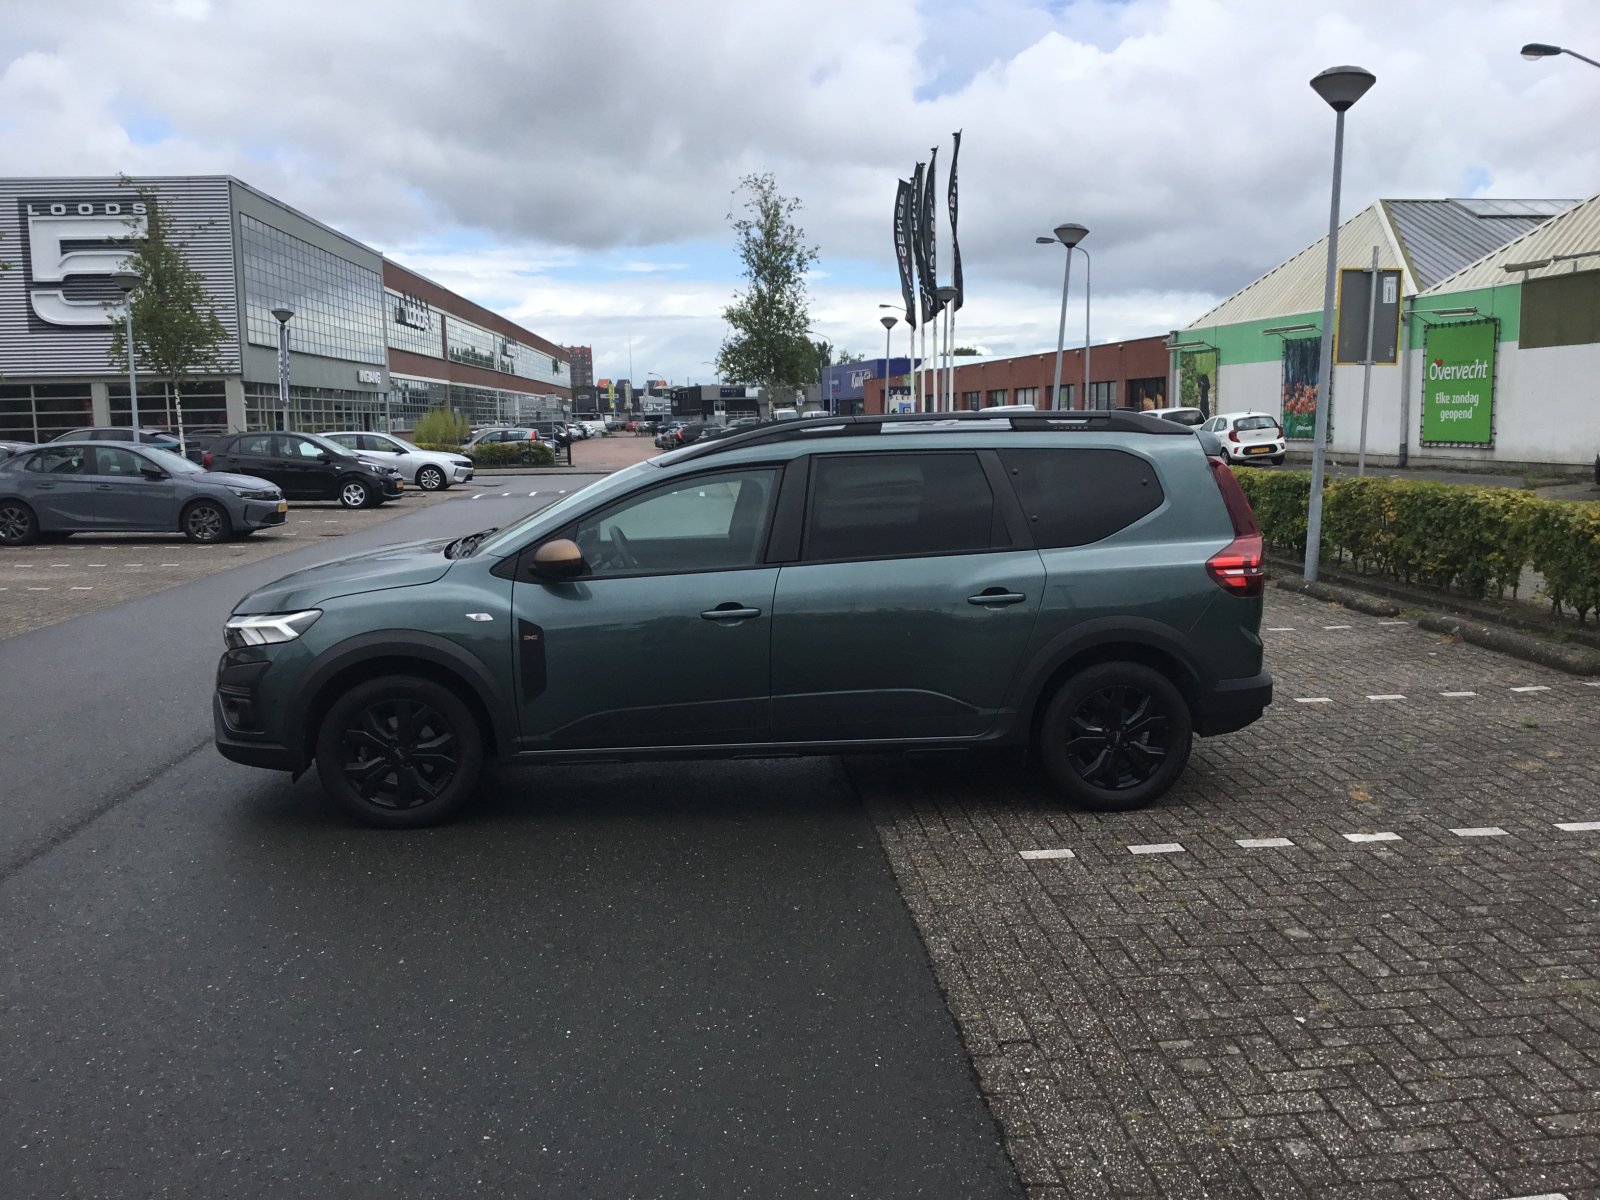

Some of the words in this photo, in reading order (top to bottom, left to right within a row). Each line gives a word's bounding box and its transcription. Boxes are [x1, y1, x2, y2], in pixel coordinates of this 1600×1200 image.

[27, 203, 147, 216] LOODS
[28, 215, 148, 326] 5
[1429, 359, 1489, 381] Overvecht
[1435, 391, 1451, 404] Elke
[1452, 390, 1480, 407] zondag
[1440, 406, 1473, 422] geopend
